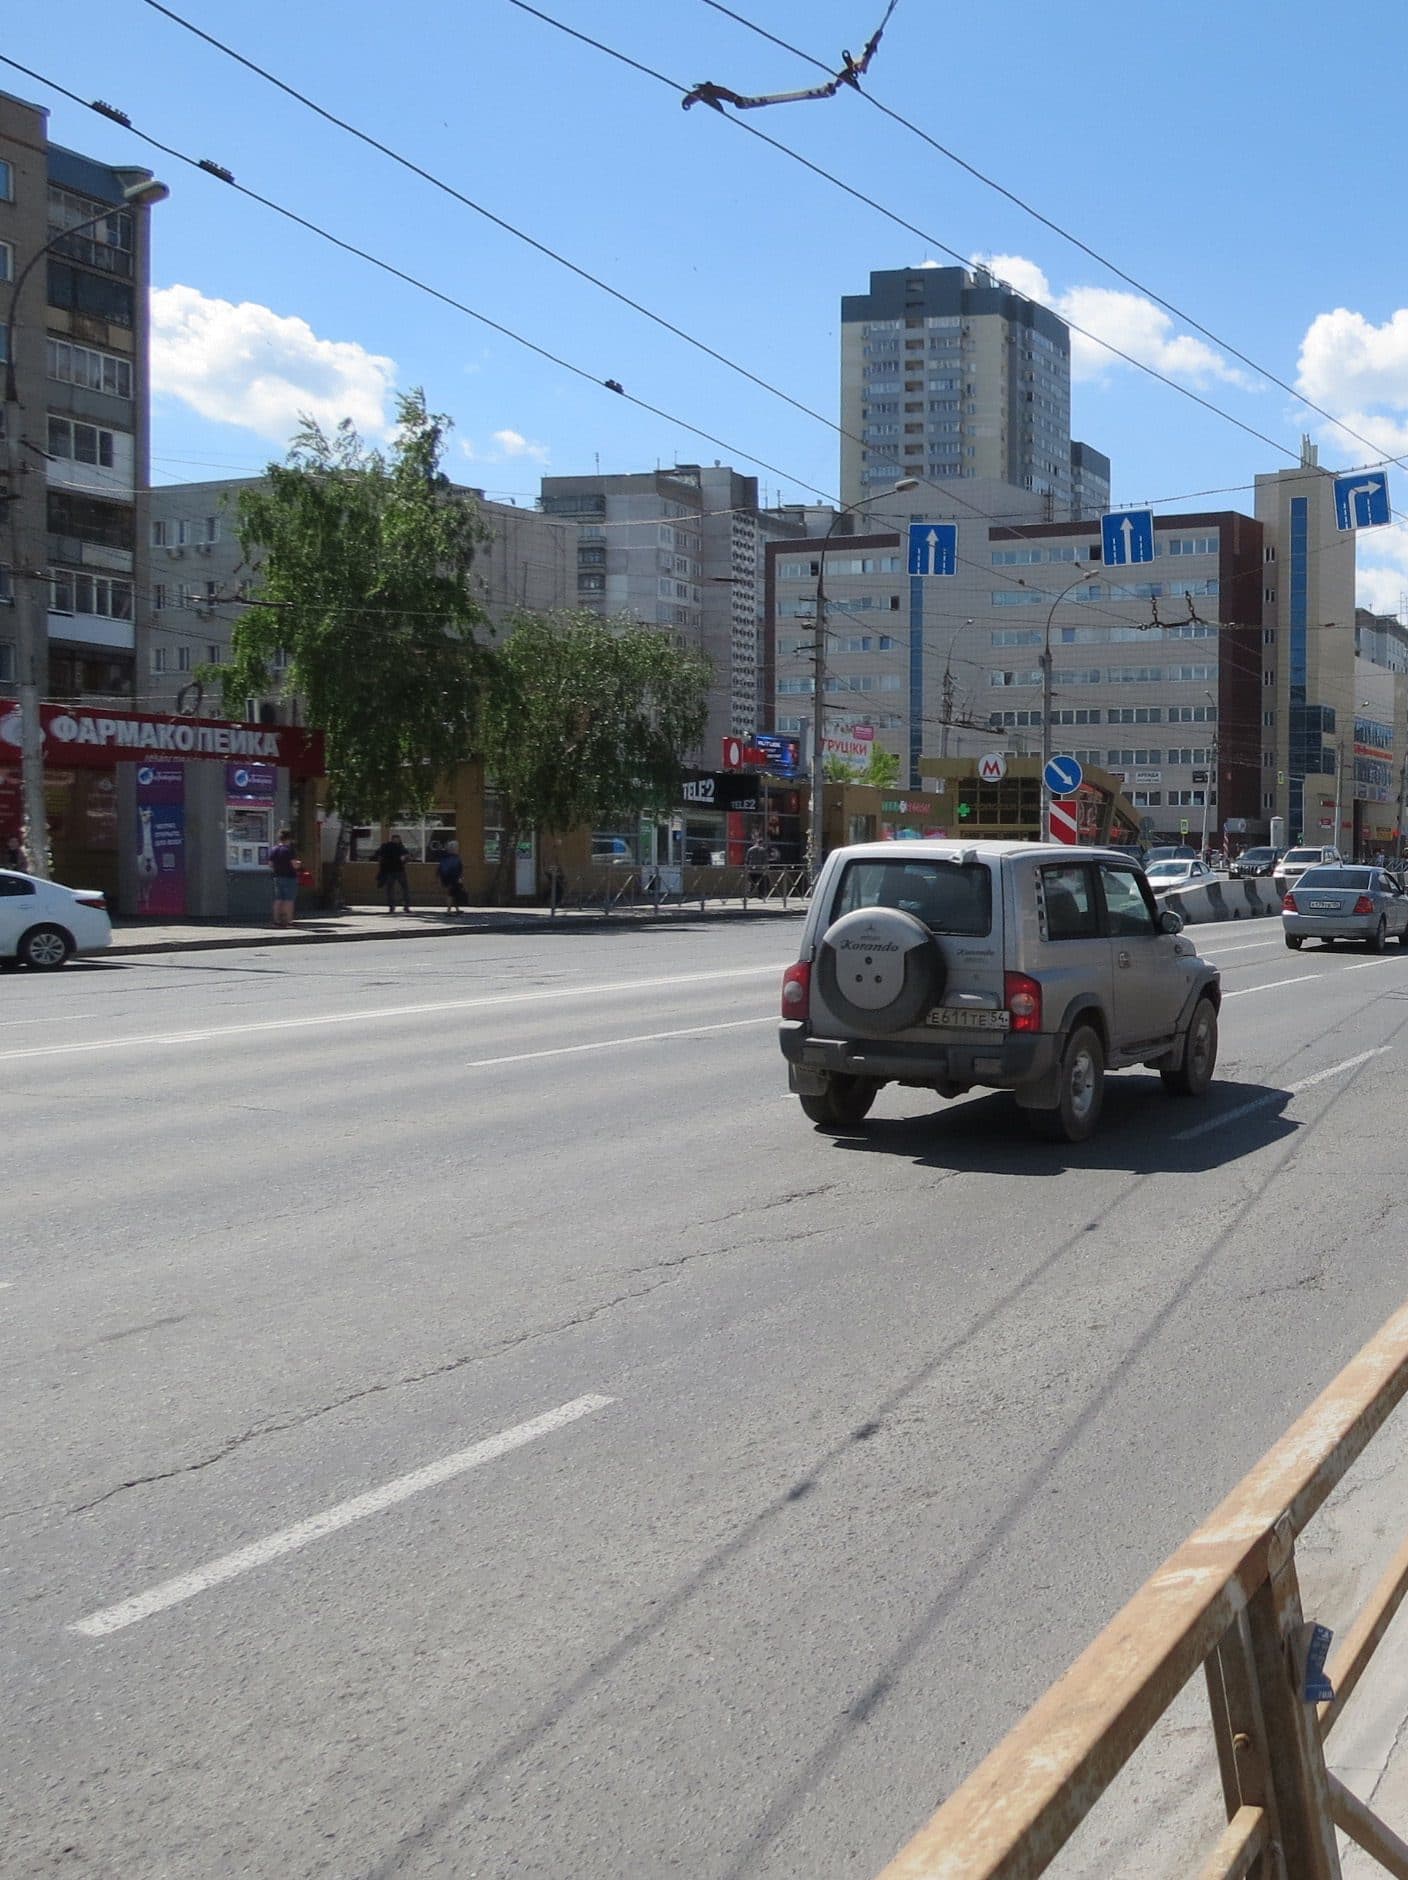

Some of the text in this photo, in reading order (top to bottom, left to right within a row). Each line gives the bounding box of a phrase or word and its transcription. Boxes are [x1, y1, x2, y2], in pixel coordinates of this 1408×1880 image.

[820, 738, 868, 756] ГРУШКИ
[983, 760, 1001, 776] М
[682, 778, 715, 802] TELE2
[730, 799, 756, 809] TELE2
[839, 940, 899, 952] Korando
[932, 1010, 1005, 1024] Е611ТЕ 54
